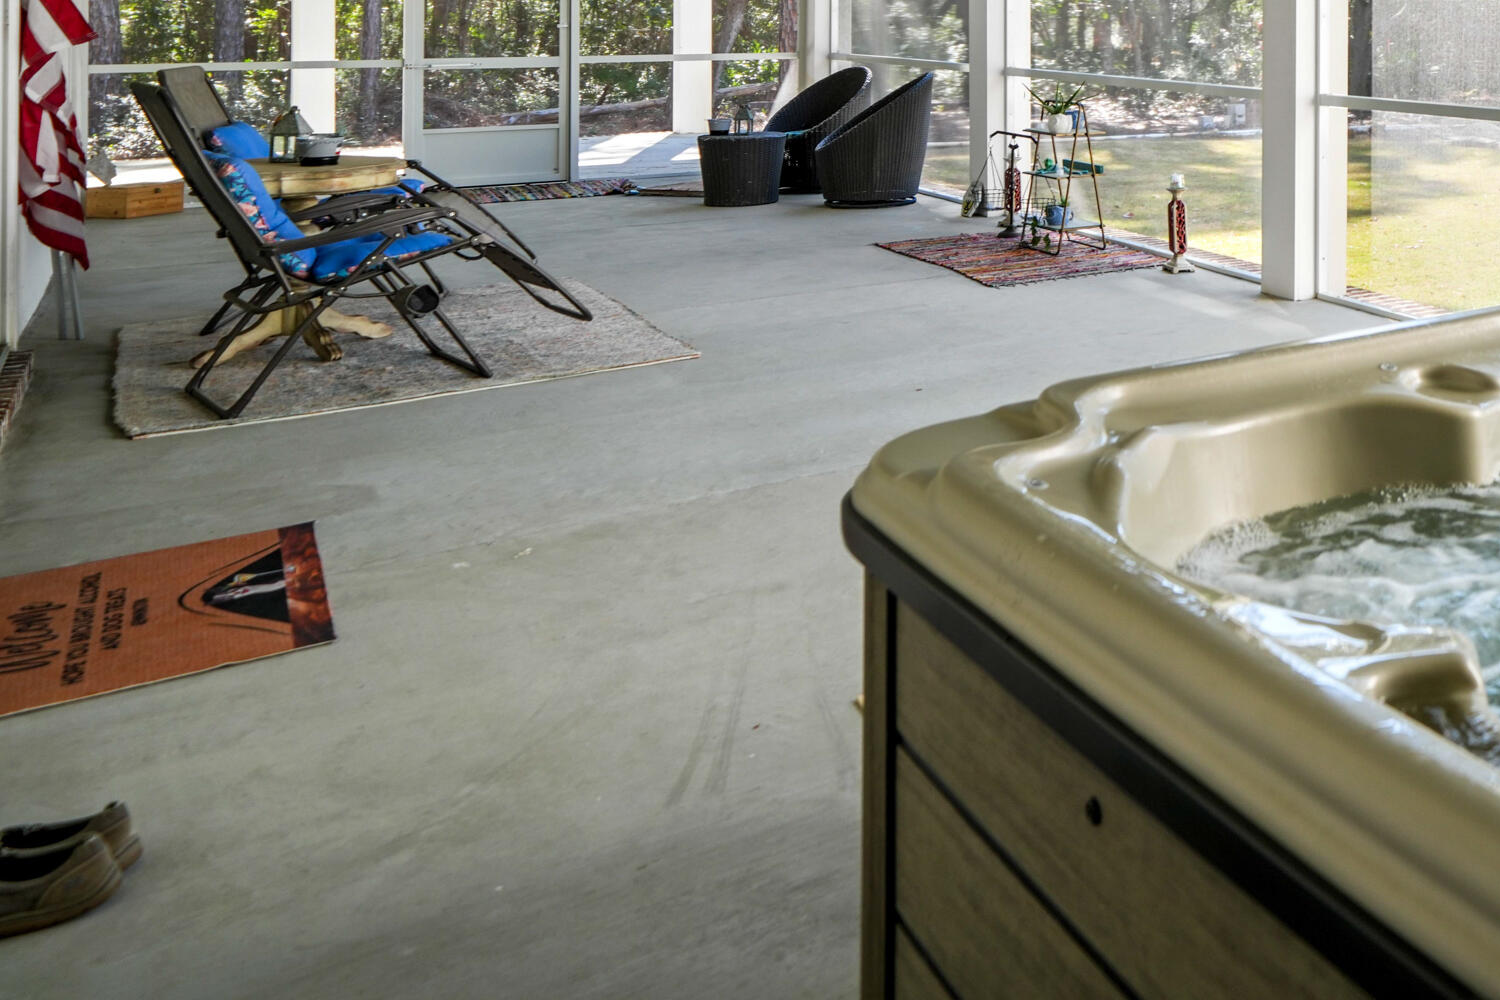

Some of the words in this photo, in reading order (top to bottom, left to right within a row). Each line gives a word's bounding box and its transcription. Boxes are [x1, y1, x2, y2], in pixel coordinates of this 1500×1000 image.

[102, 613, 123, 633] DOG
[101, 632, 122, 650] AND
[66, 642, 89, 660] YOU
[61, 660, 87, 686] HOPE
